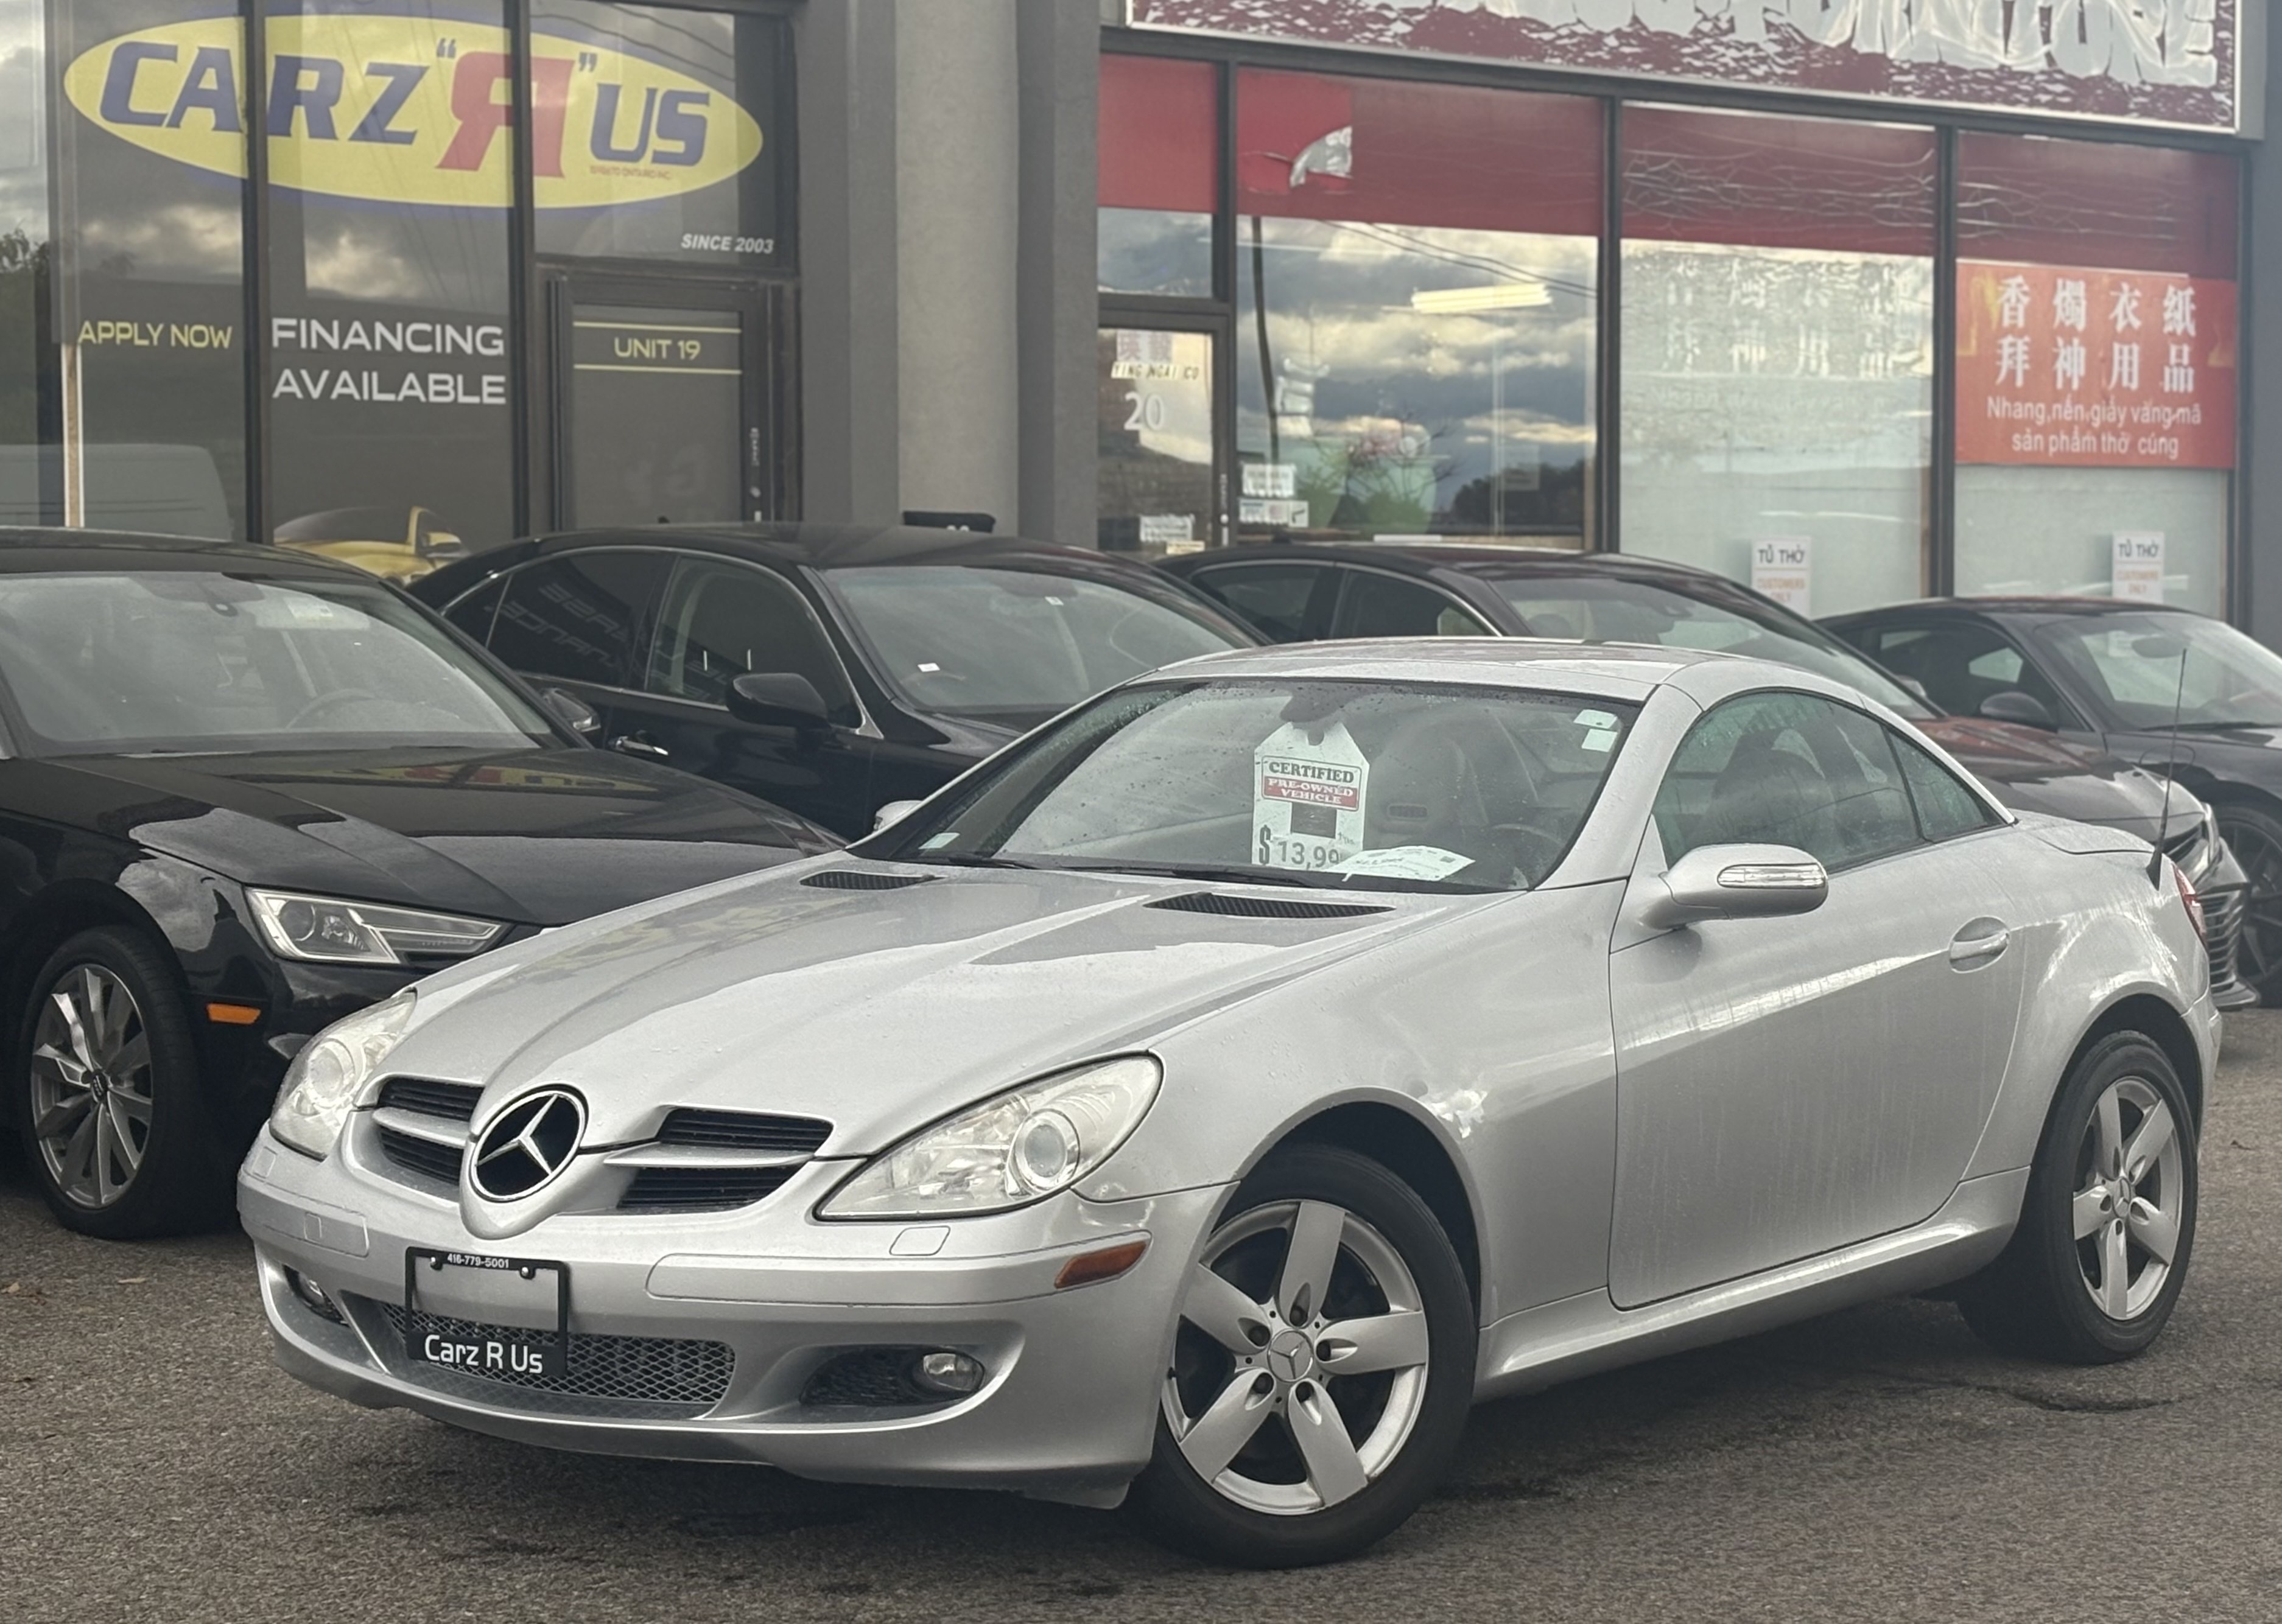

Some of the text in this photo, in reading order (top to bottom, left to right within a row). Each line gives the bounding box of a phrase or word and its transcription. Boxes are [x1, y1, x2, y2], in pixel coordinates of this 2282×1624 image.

[100, 41, 429, 145] CARZ
[590, 83, 711, 166] US
[681, 233, 774, 254] SINCE 2003
[78, 320, 232, 349] APPLY NOW
[272, 318, 505, 356] FINANCING
[614, 337, 701, 360] UNIT 19
[1995, 334, 2195, 393] 拜神用品
[272, 368, 507, 404] AVAILABLE
[1124, 391, 1164, 430] 20
[2138, 432, 2178, 460] cúng
[1269, 761, 1354, 783] CERTIFIED
[1268, 778, 1353, 797] PRE-OWNED
[1281, 788, 1342, 804] VEHICLE
[448, 1253, 509, 1269] 416-779-5001
[425, 1334, 543, 1374] Carz R Us
